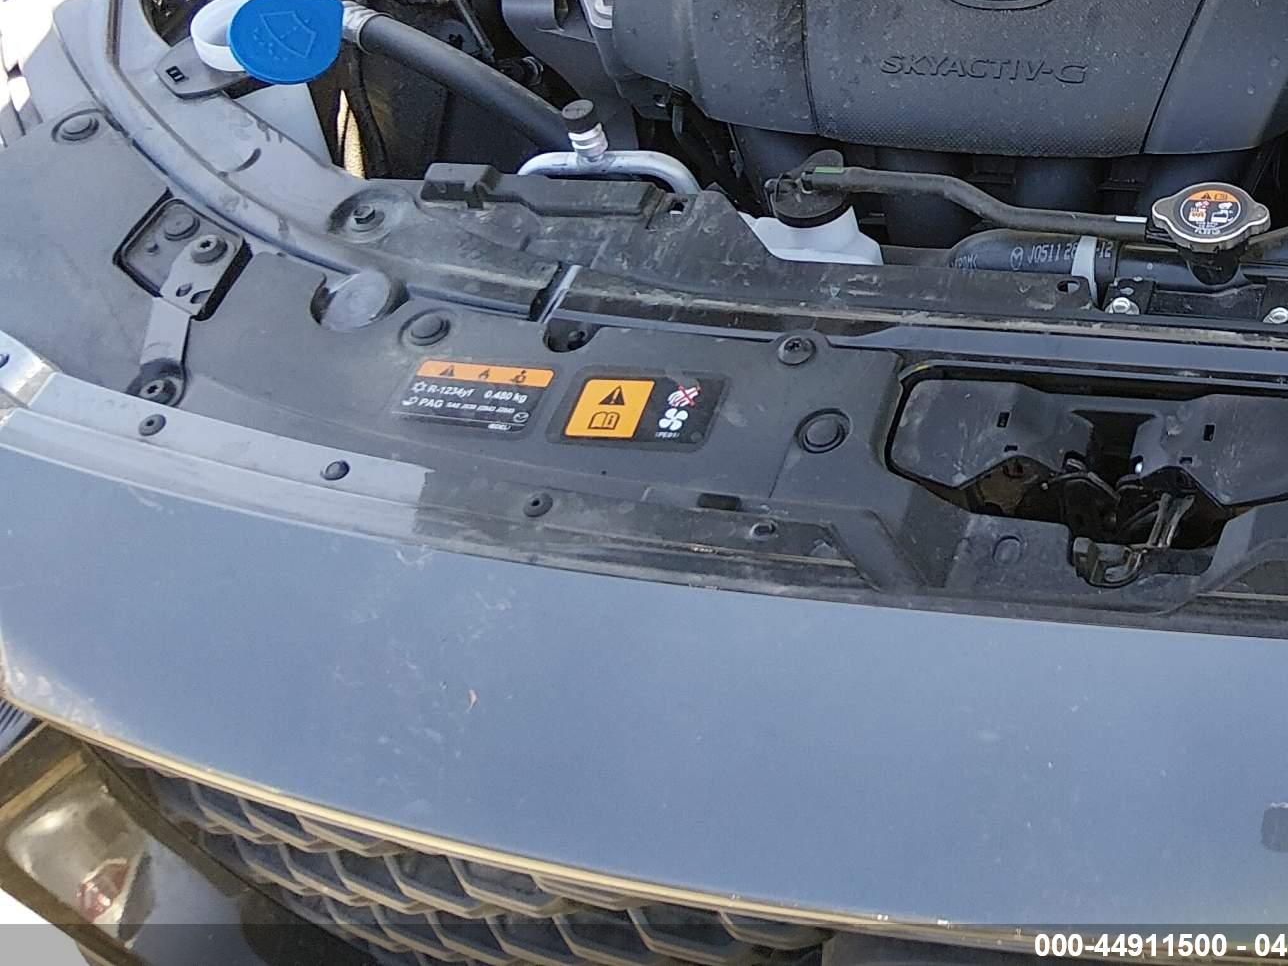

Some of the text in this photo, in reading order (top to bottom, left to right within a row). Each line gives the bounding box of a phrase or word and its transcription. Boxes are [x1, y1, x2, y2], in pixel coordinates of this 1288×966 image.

[880, 55, 1089, 84] SKYACTIV-G
[1028, 243, 1061, 264] J0511
[418, 398, 444, 408] PAG
[427, 384, 475, 398] R-1234yf
[513, 393, 528, 404] kg
